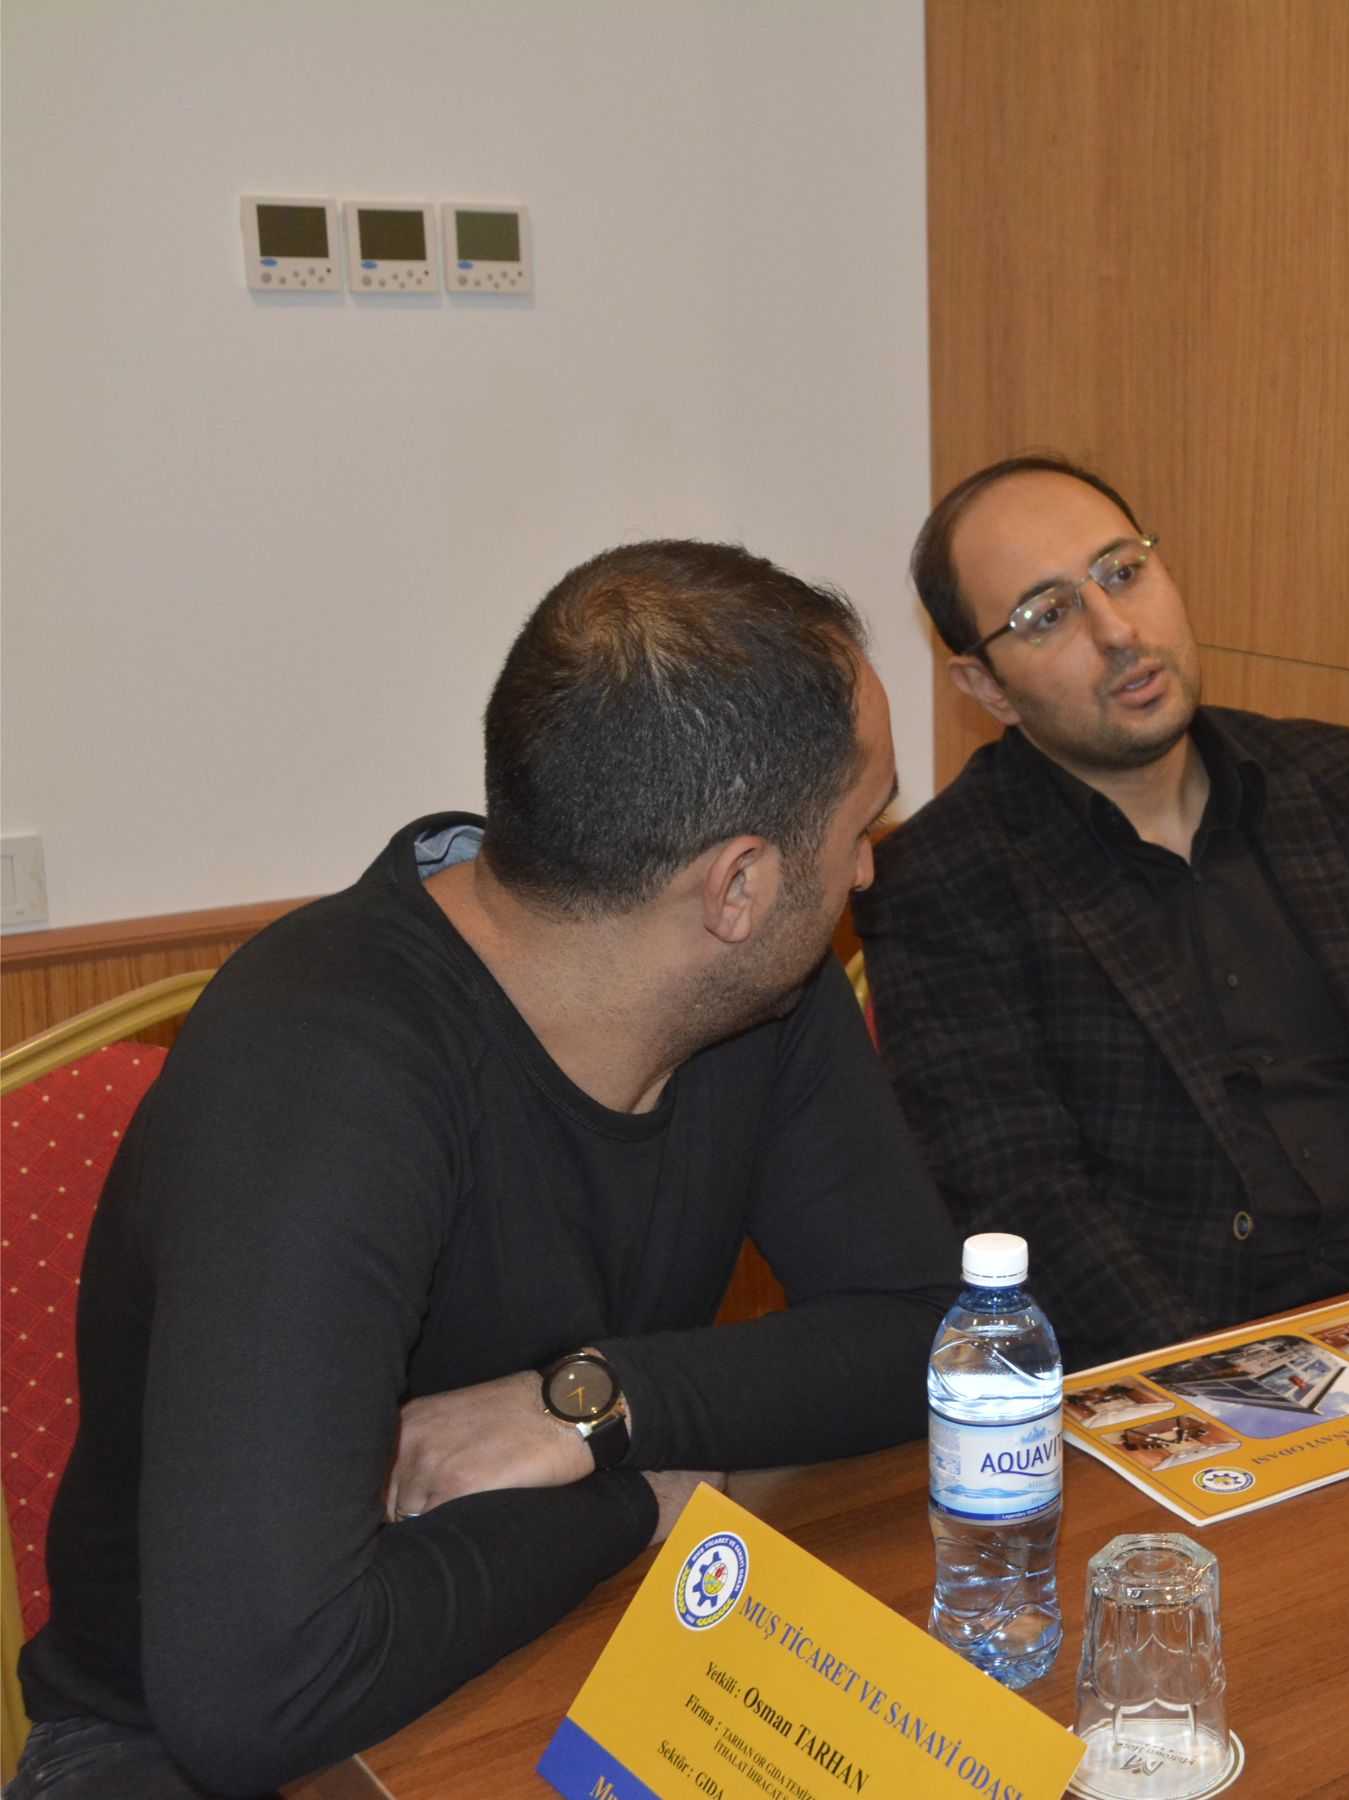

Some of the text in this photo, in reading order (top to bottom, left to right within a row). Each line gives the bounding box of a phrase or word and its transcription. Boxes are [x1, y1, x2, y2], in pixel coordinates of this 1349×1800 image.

[1252, 1444, 1305, 1465] ODASI
[739, 1595, 781, 1640] MUŞ
[778, 1622, 862, 1695] TİCARET
[860, 1680, 888, 1716] VE
[883, 1701, 962, 1769] SANAYİ
[713, 1739, 748, 1773] İTHALAT
[722, 1726, 755, 1758] TARHAN
[765, 1762, 786, 1785] GIDA
[743, 1687, 793, 1738] Osman
[793, 1723, 870, 1795] TARHAN
[695, 1771, 725, 1800] GIDA
